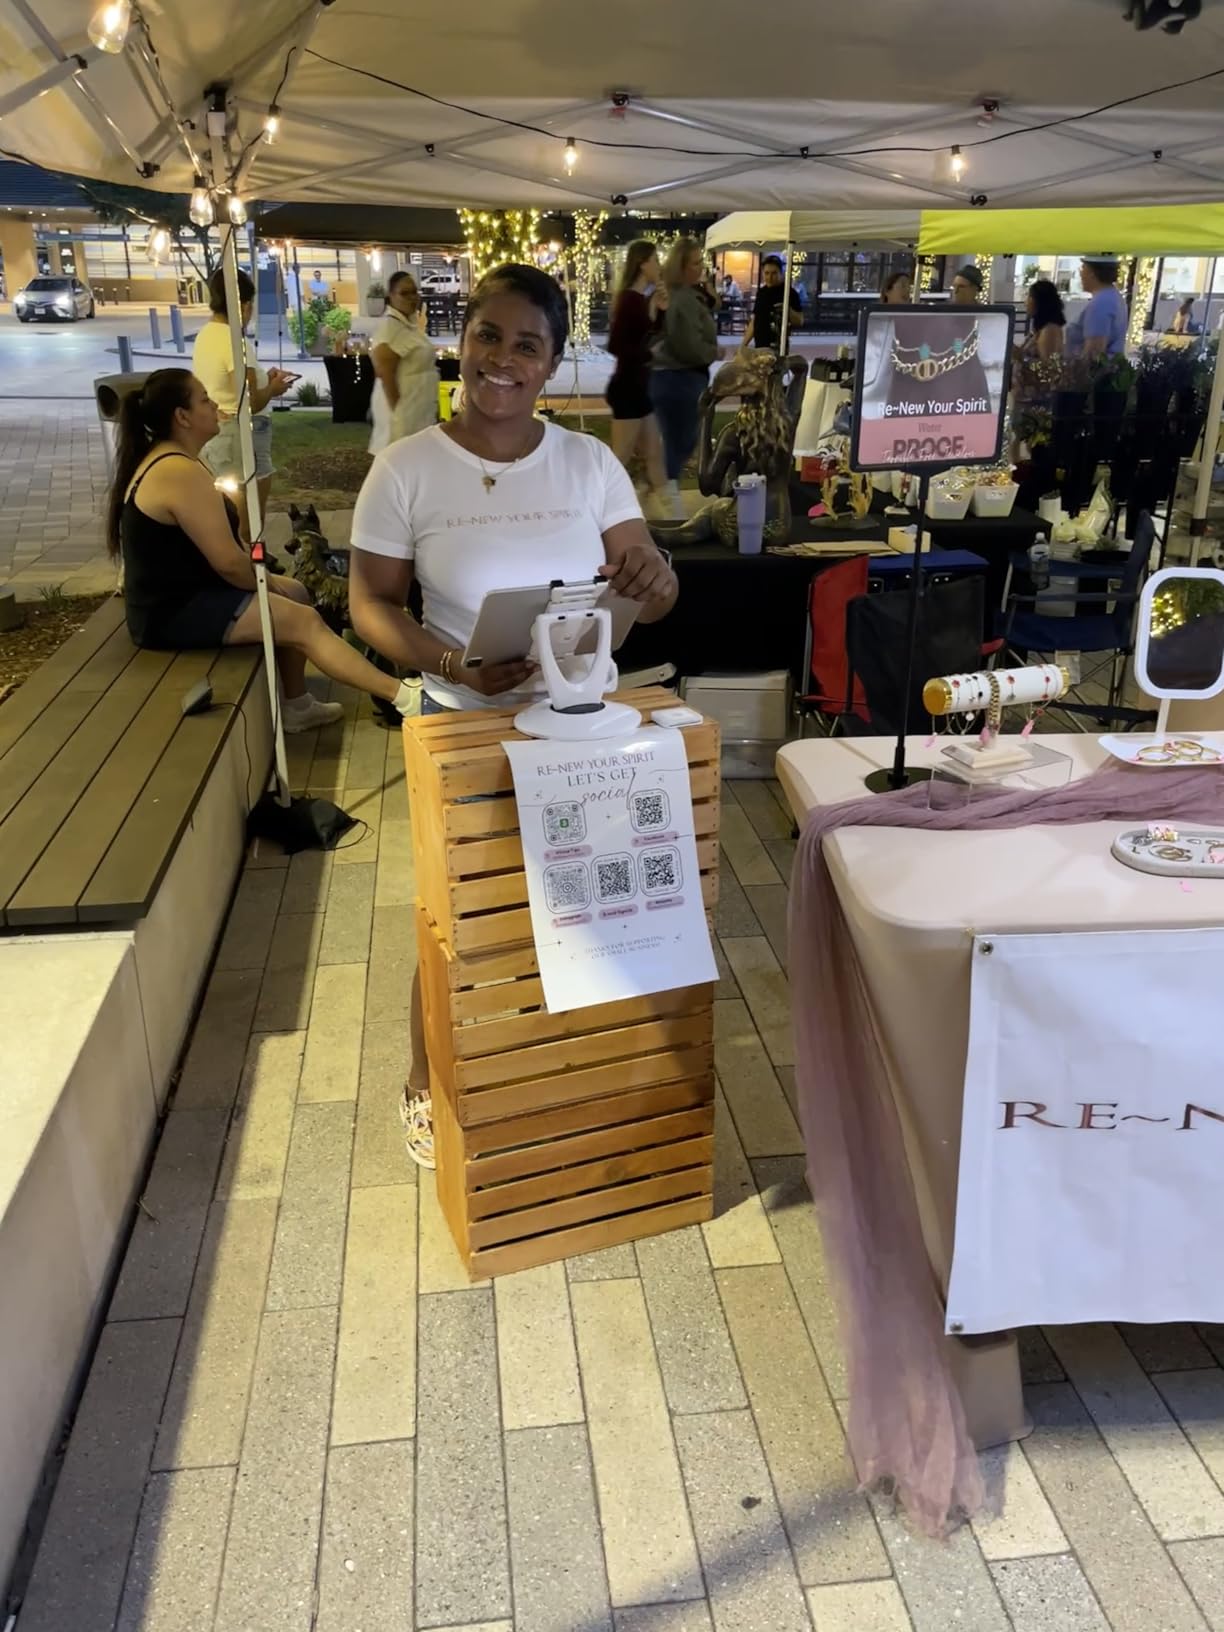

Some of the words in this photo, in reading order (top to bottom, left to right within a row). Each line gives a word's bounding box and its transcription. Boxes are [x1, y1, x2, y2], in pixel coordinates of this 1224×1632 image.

[878, 401, 925, 416] Re~New
[928, 400, 954, 413] Your
[956, 398, 987, 415] Spirit
[588, 755, 621, 770] YOUR
[622, 751, 656, 765] SPIRIT
[567, 772, 605, 787] LET'S
[610, 767, 637, 780] GET
